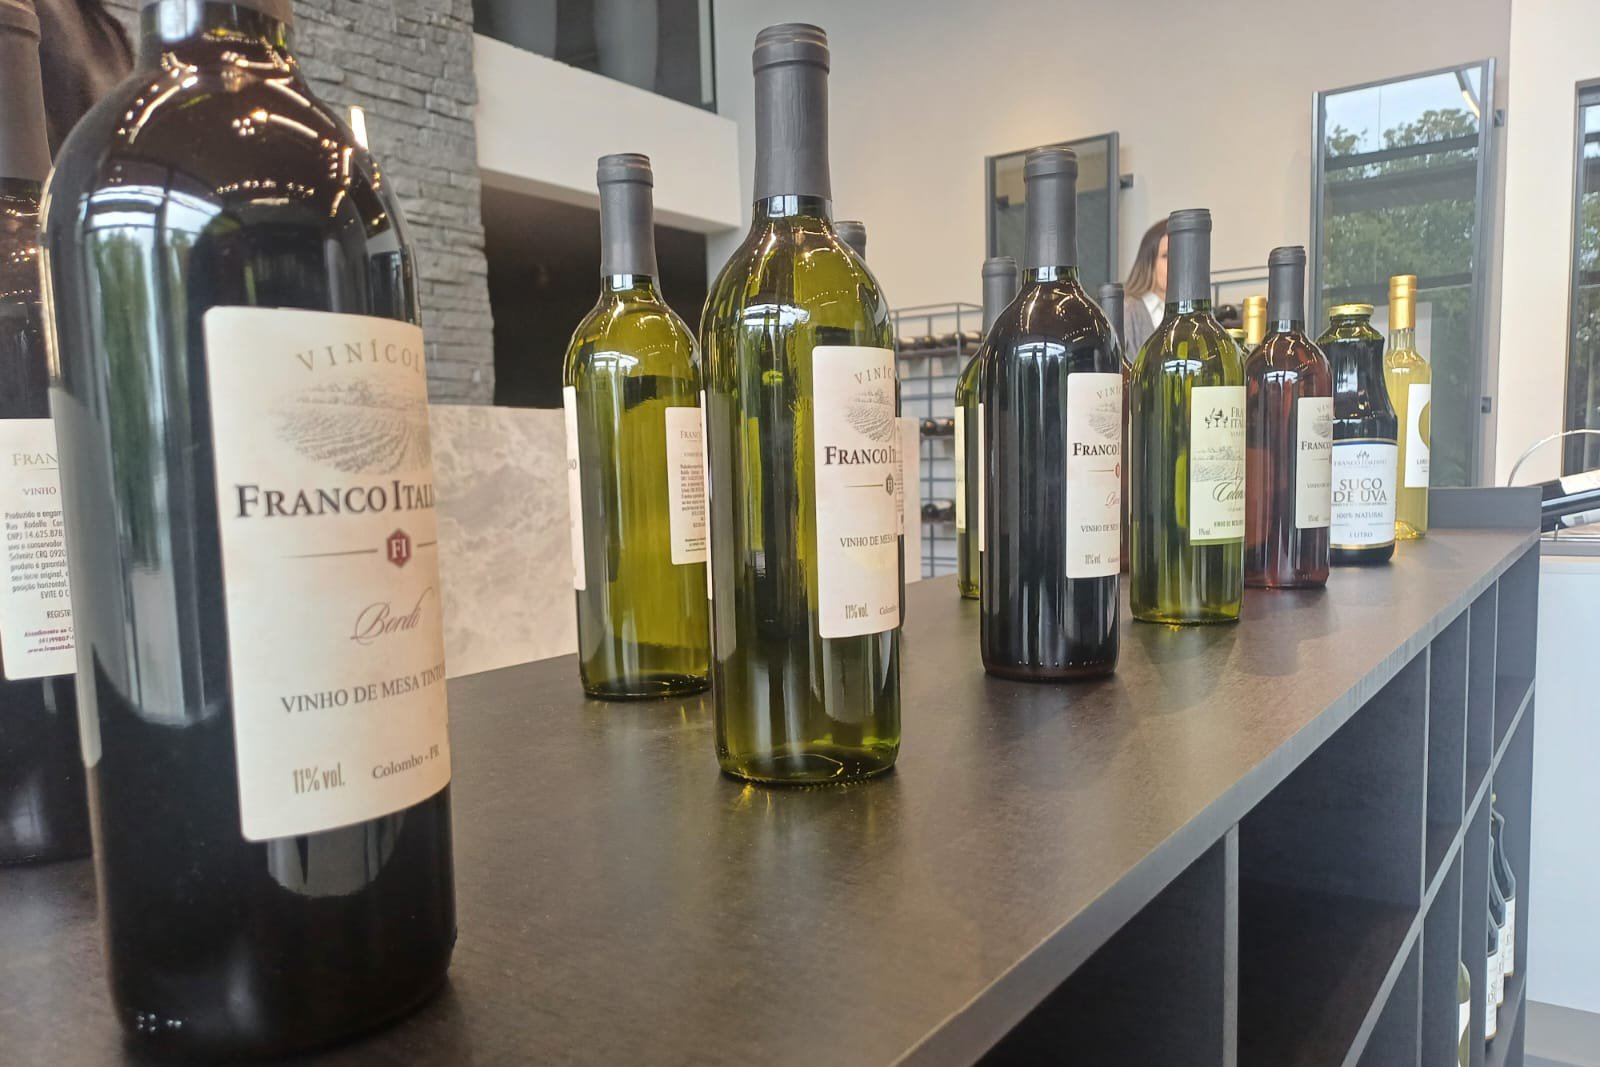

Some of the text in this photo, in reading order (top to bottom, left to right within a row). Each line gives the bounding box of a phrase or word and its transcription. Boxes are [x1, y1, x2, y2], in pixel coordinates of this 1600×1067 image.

[22, 486, 57, 496] VINHO
[1339, 477, 1383, 492] SUCO
[1333, 489, 1388, 503] DE UVA
[1336, 511, 1353, 520] 100%
[1355, 511, 1384, 519] NATURAL
[840, 536, 868, 548] VINHO
[869, 535, 879, 546] DE
[281, 690, 349, 713] VINHO
[353, 684, 378, 704] DE
[381, 674, 420, 699] MESA
[372, 753, 424, 779] Colombo
